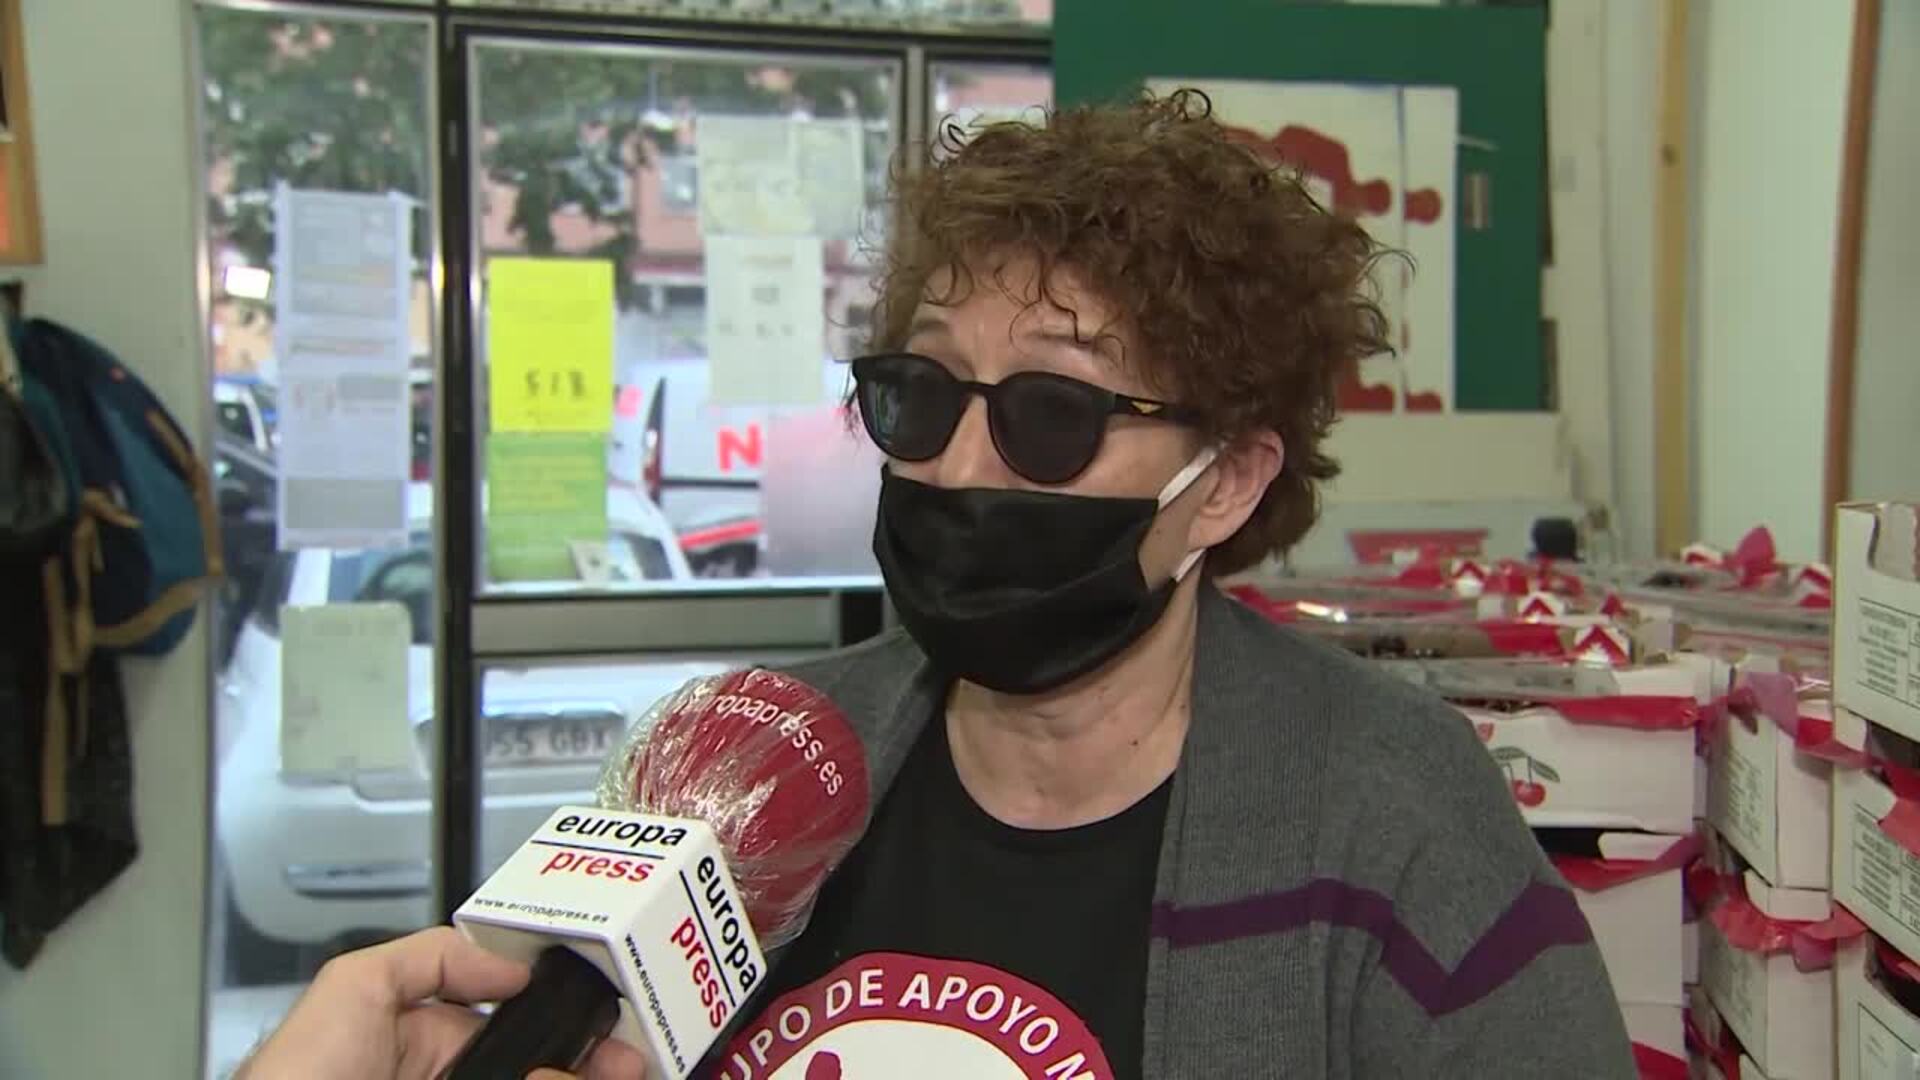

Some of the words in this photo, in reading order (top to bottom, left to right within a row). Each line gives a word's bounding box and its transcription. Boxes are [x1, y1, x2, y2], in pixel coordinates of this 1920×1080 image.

[540, 851, 654, 883] press
[555, 815, 688, 847] europa
[671, 917, 727, 1029] press
[697, 856, 757, 994] europa
[624, 932, 686, 1073] www.europapress.es
[826, 969, 884, 1018] DE
[898, 973, 1059, 1054] APOYO
